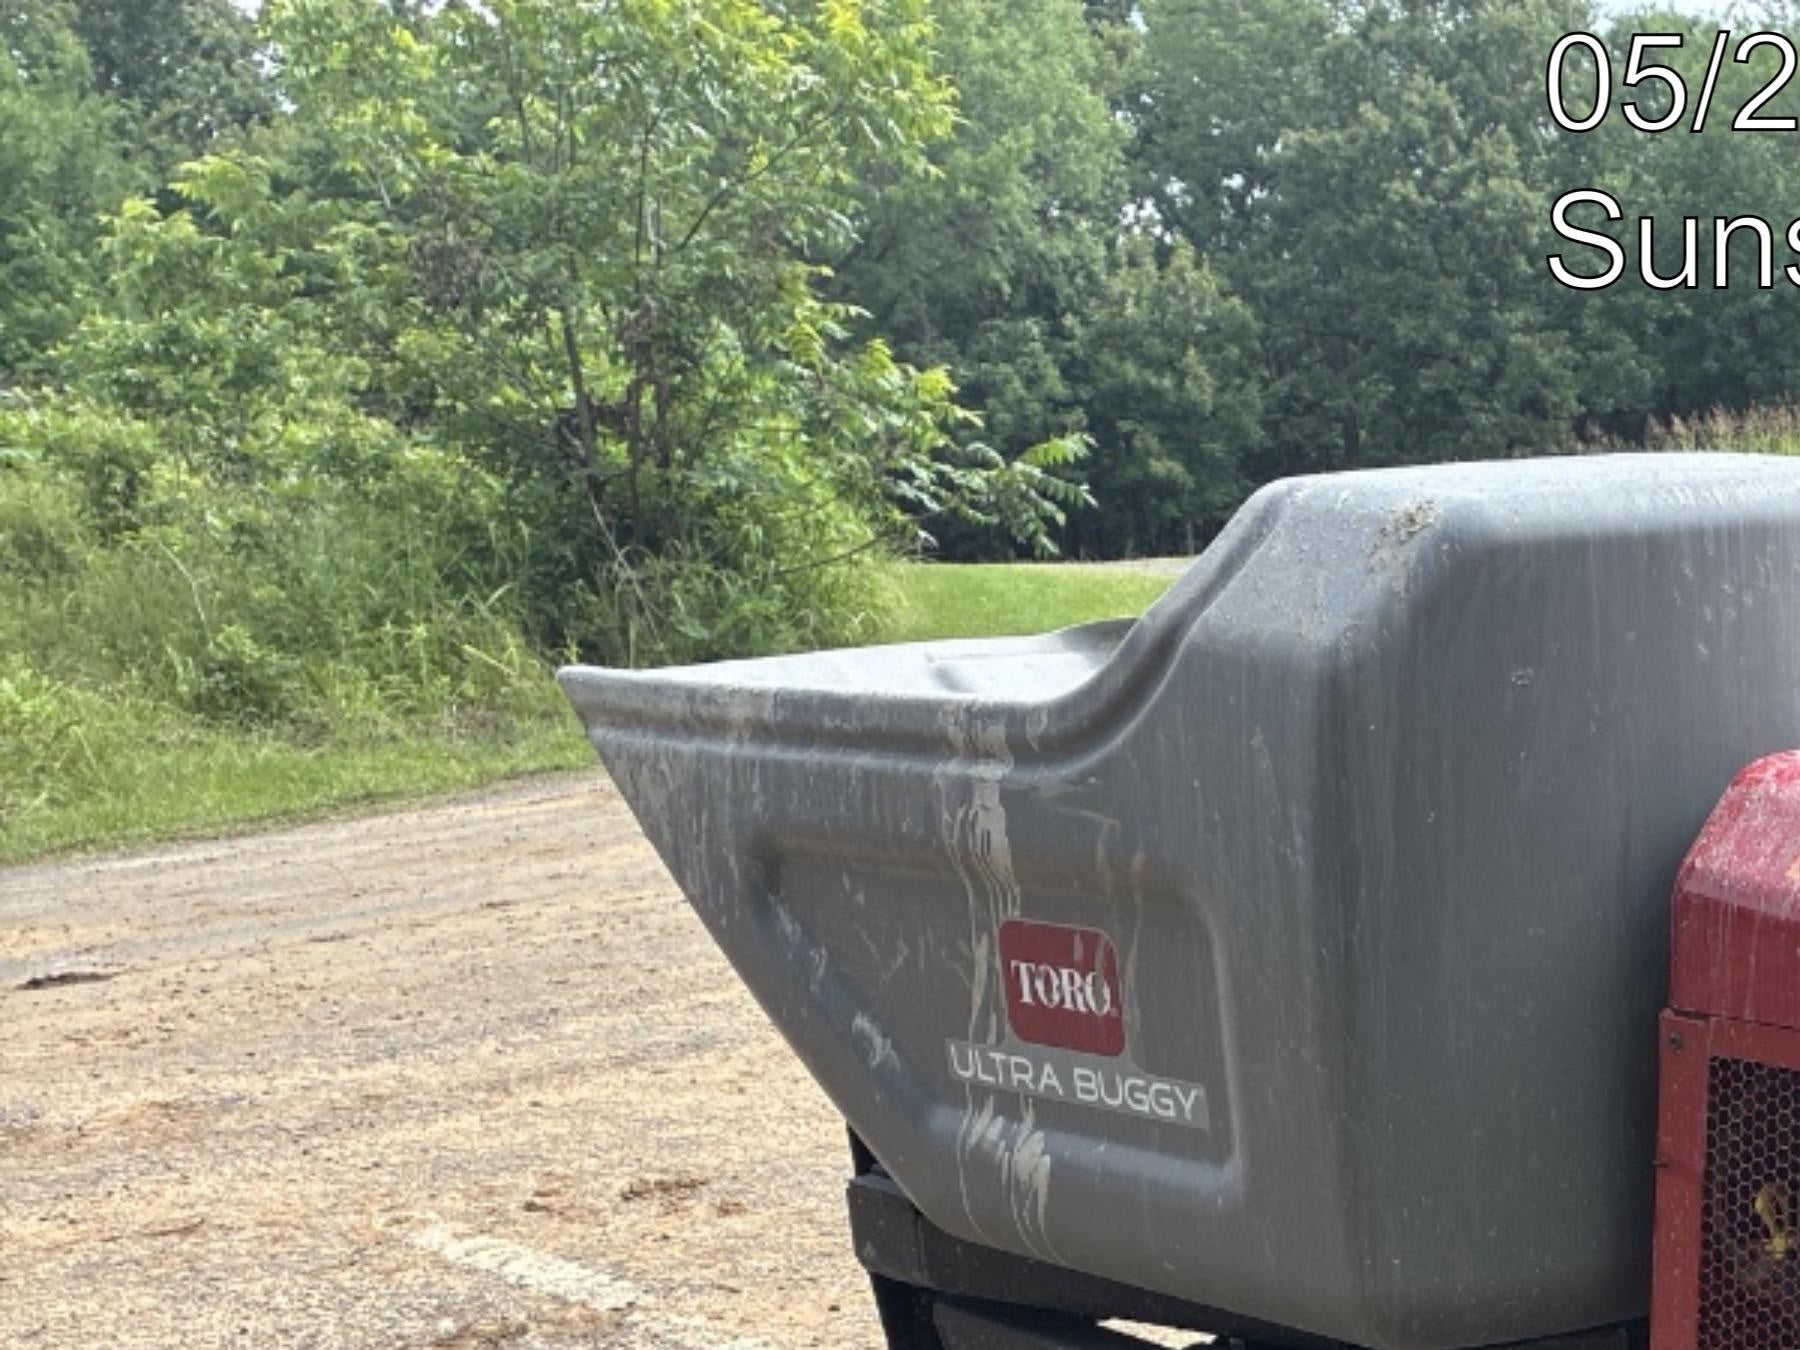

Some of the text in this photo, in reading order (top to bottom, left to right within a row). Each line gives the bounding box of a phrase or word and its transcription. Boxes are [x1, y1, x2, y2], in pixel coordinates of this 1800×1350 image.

[1010, 959, 1112, 1016] TORO
[950, 1045, 1199, 1121] ULTRA BUGGY
